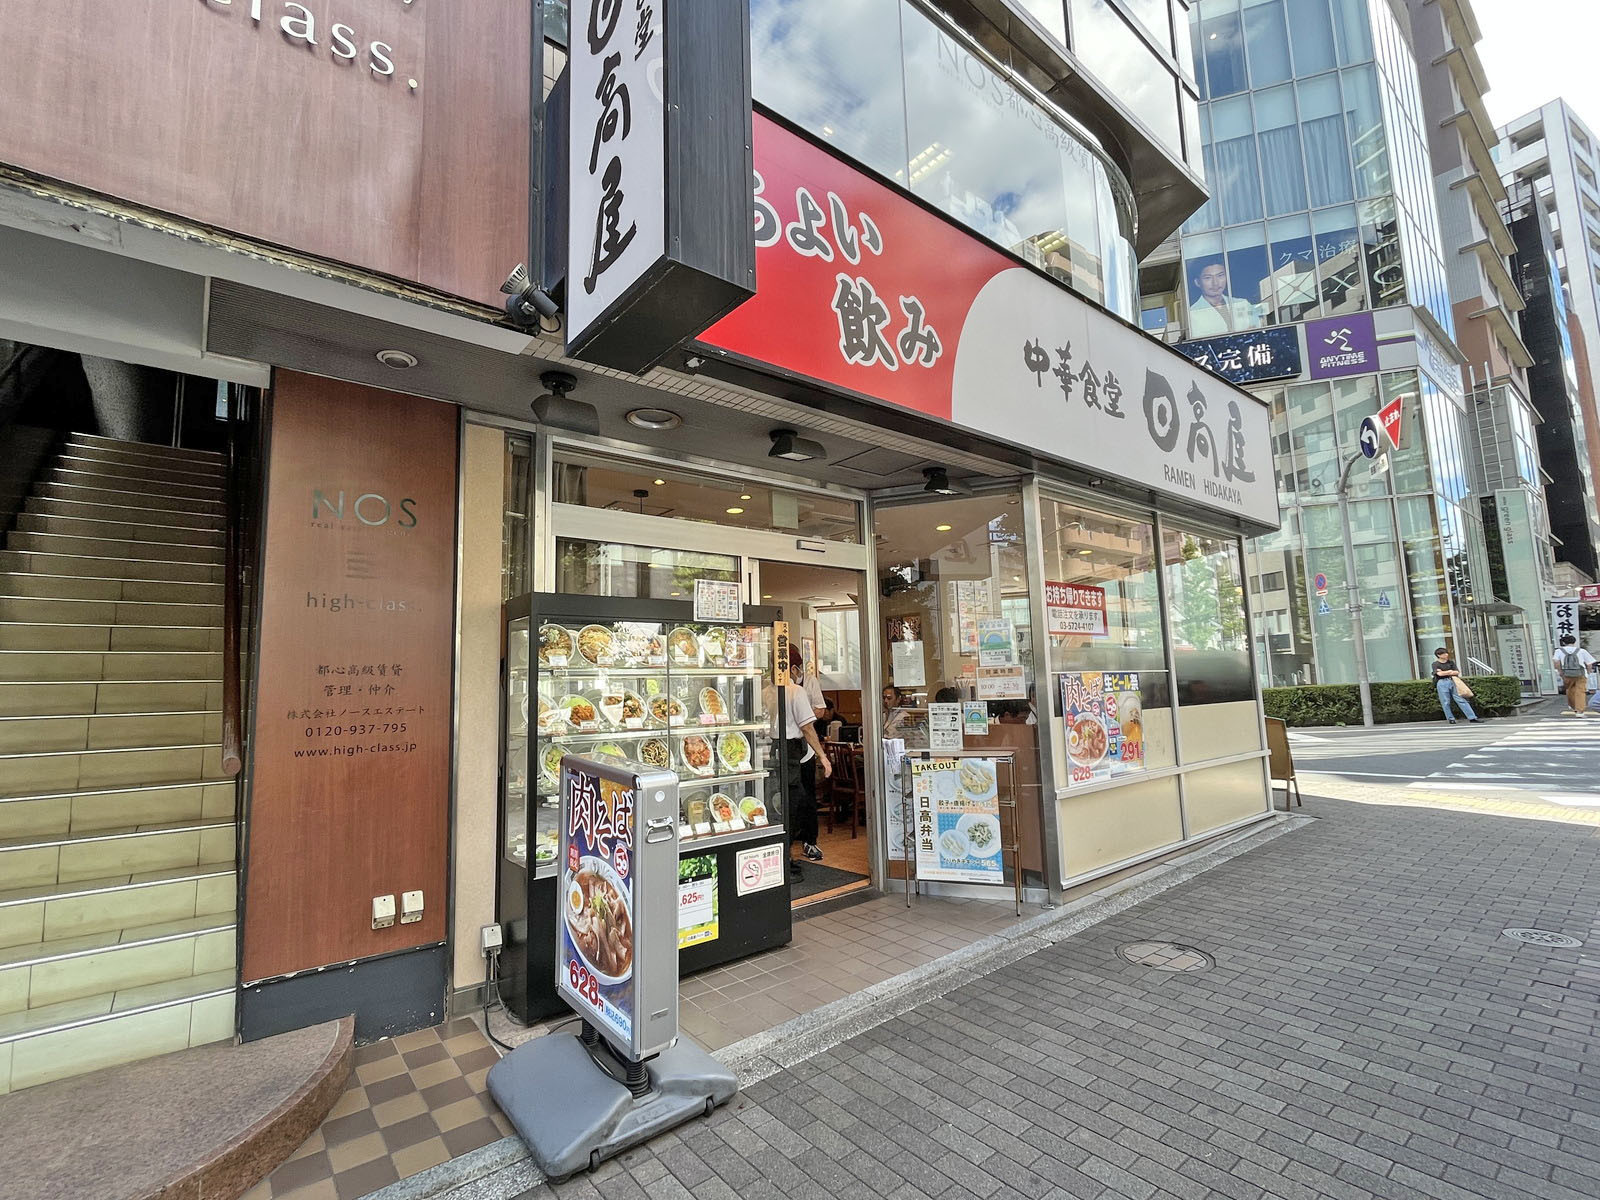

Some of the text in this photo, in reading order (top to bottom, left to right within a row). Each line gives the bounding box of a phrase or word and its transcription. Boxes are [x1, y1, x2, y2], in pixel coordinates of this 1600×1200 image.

[831, 272, 943, 372] 飲み
[1024, 337, 1125, 419] 中華食堂
[1143, 366, 1256, 483] 日高屋
[1164, 464, 1243, 506] RAMEN HIDAKAYA
[312, 489, 417, 528] NOS
[1046, 585, 1103, 608] お持ち帰りできます
[1060, 621, 1095, 631] 03-5724-4107
[316, 664, 404, 677] 都心高級賃貸
[1104, 673, 1140, 692] 生ビール祭
[324, 684, 396, 697] 管理・仲介
[1064, 674, 1102, 713] 肉そば
[287, 705, 425, 720] 株式会社ノースエステート
[305, 723, 407, 738] 0120-937-795
[294, 742, 417, 758] www.high-class.jp
[569, 771, 634, 860] 肉そば
[920, 797, 932, 851] 日高弁当
